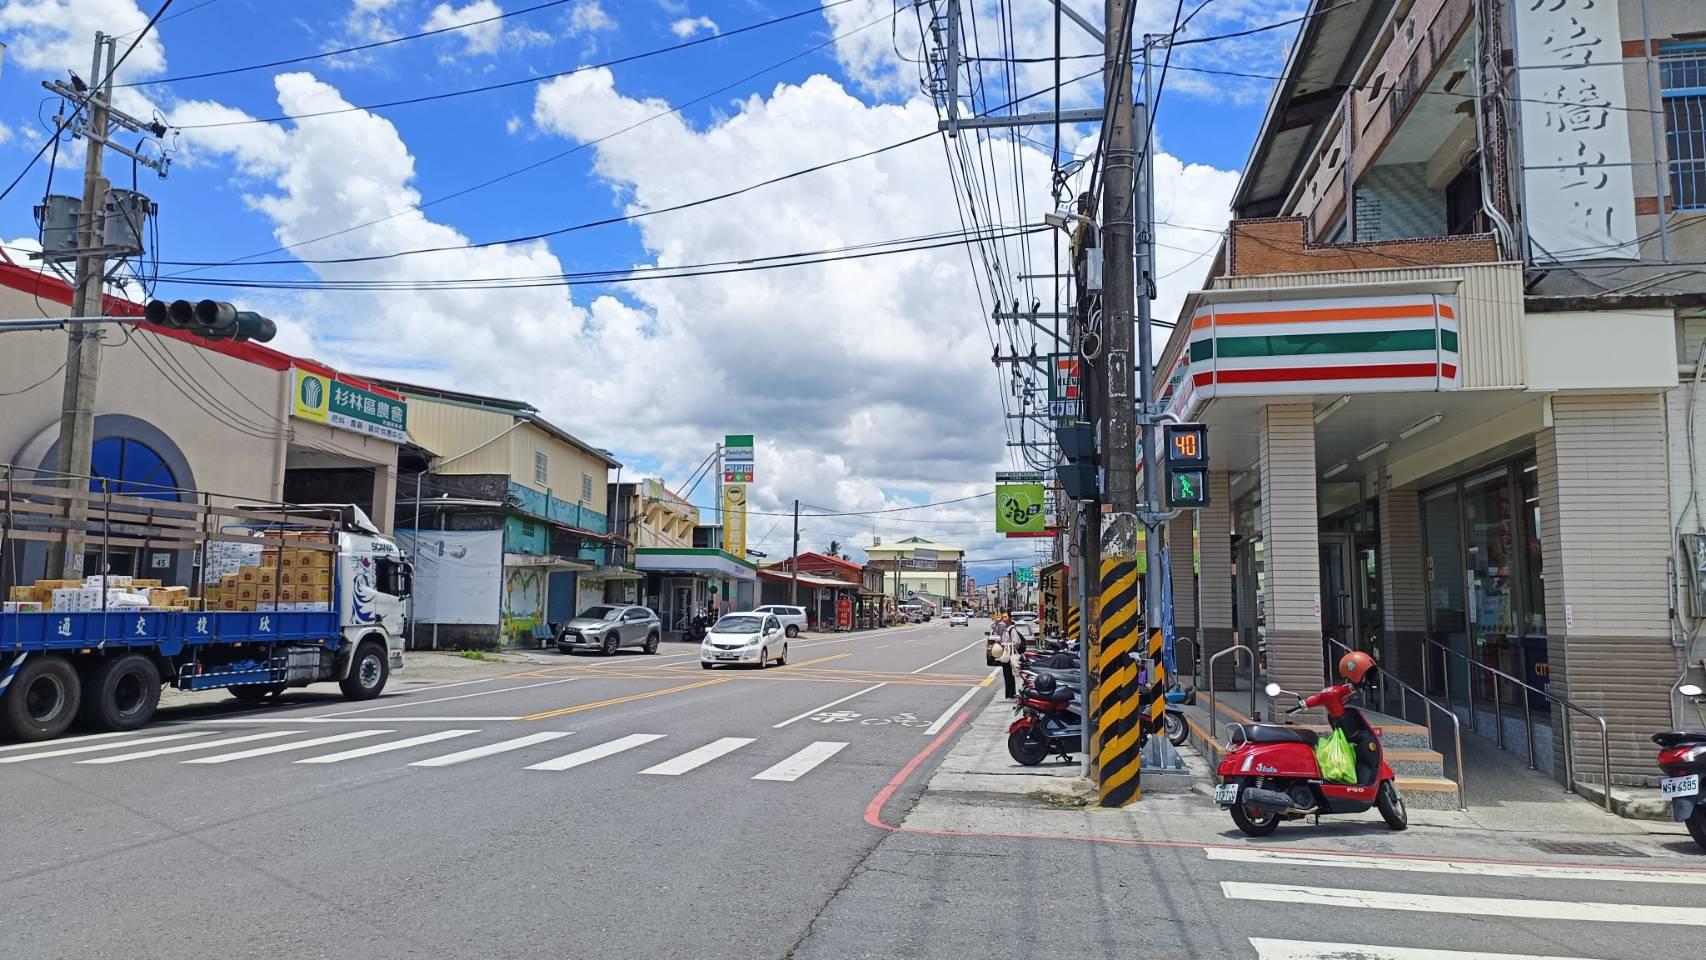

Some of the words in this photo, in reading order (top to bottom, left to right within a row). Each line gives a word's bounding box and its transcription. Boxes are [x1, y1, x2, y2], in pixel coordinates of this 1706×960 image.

[335, 387, 403, 423] 杉林區農會
[1175, 435, 1196, 456] 40
[371, 542, 394, 552] SCANIA
[1535, 662, 1549, 676] CIT
